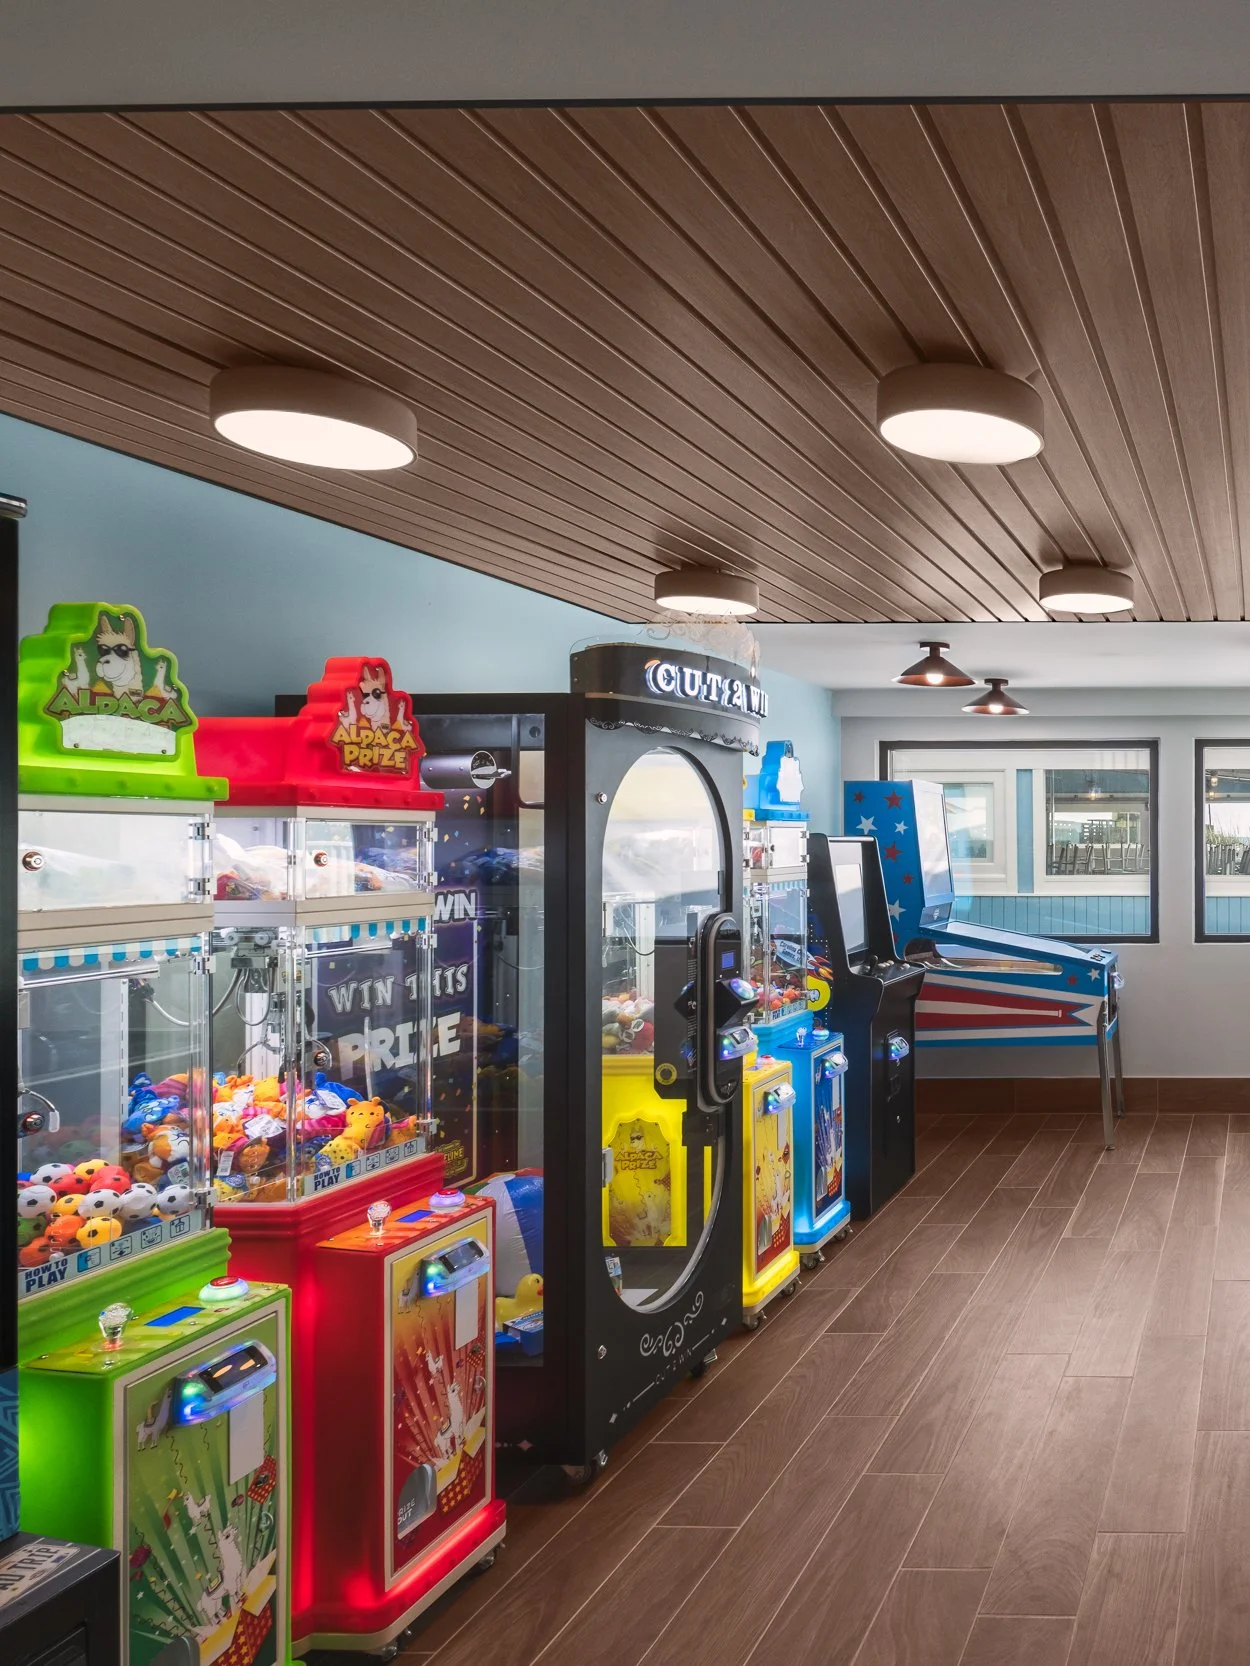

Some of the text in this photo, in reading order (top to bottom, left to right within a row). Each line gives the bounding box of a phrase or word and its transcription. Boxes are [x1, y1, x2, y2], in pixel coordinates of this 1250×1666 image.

[653, 663, 768, 717] CUT 2 WI
[47, 686, 188, 724] ALPACA
[332, 724, 418, 750] ALPACA
[343, 744, 407, 769] PRIZE
[434, 892, 476, 921] WIN
[328, 975, 395, 1013] WIN
[615, 1151, 664, 1161] ALPACA
[621, 1160, 657, 1170] PRIZE
[313, 1166, 341, 1181] HOW TO
[314, 1174, 340, 1191] PLAY
[25, 1258, 69, 1280] HOW TO
[25, 1267, 67, 1293] PLAY
[397, 1497, 416, 1517] RIZE
[7, 1547, 61, 1570] TRIP
